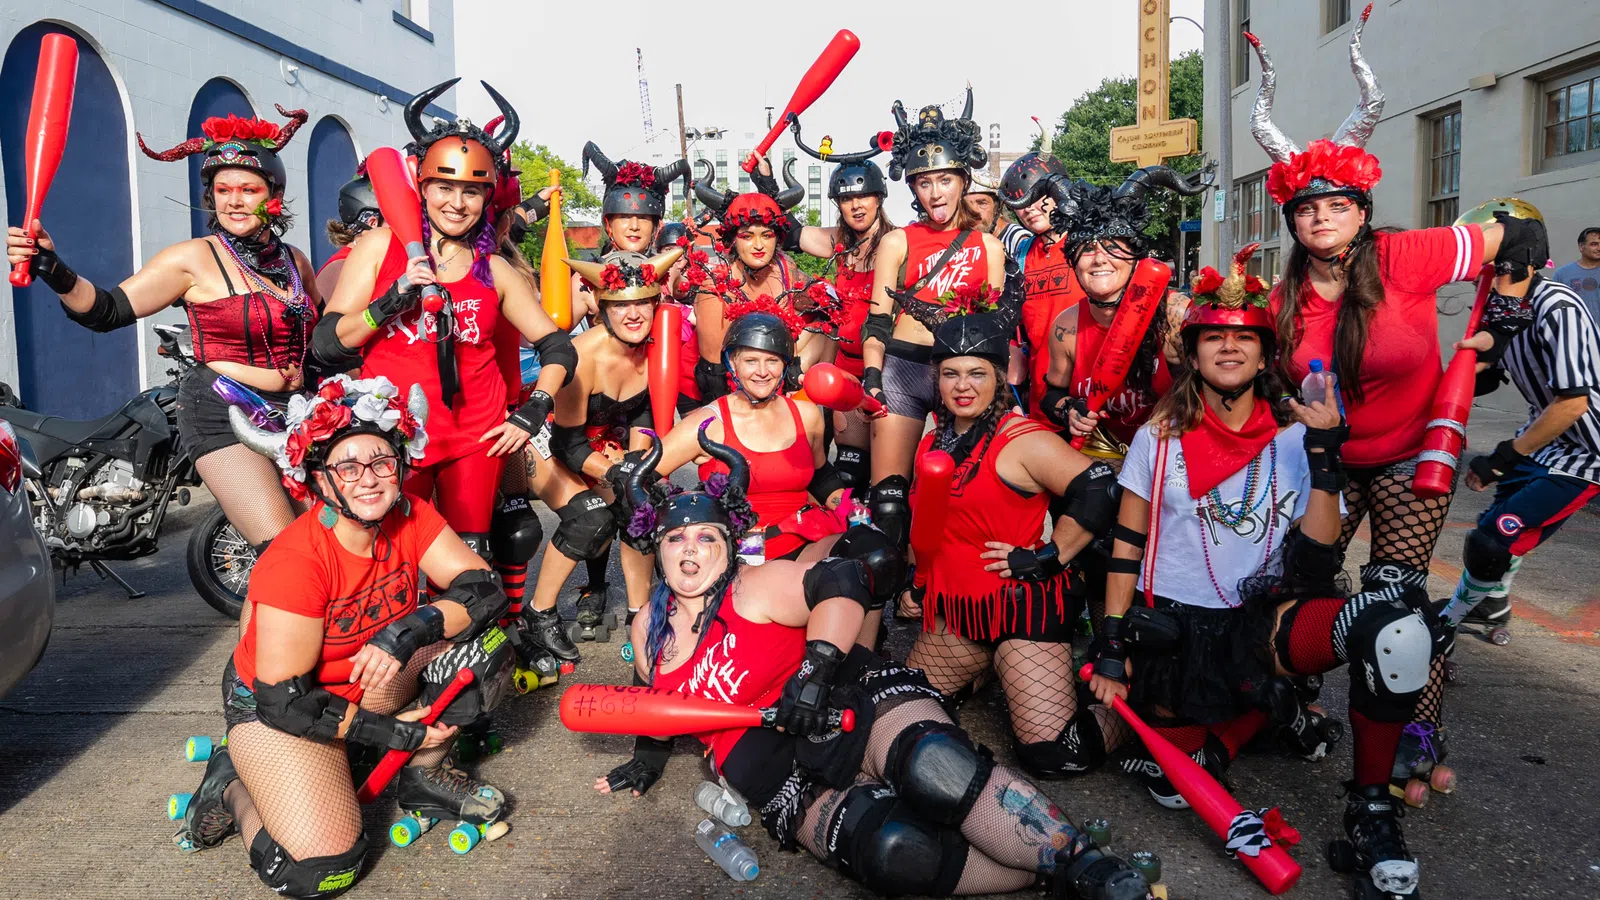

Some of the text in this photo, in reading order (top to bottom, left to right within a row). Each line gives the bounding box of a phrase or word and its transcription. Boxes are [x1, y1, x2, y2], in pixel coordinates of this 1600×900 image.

[842, 451, 860, 459] 187
[1089, 465, 1108, 475] 187
[586, 497, 603, 507] 187
[573, 694, 637, 717] #68
